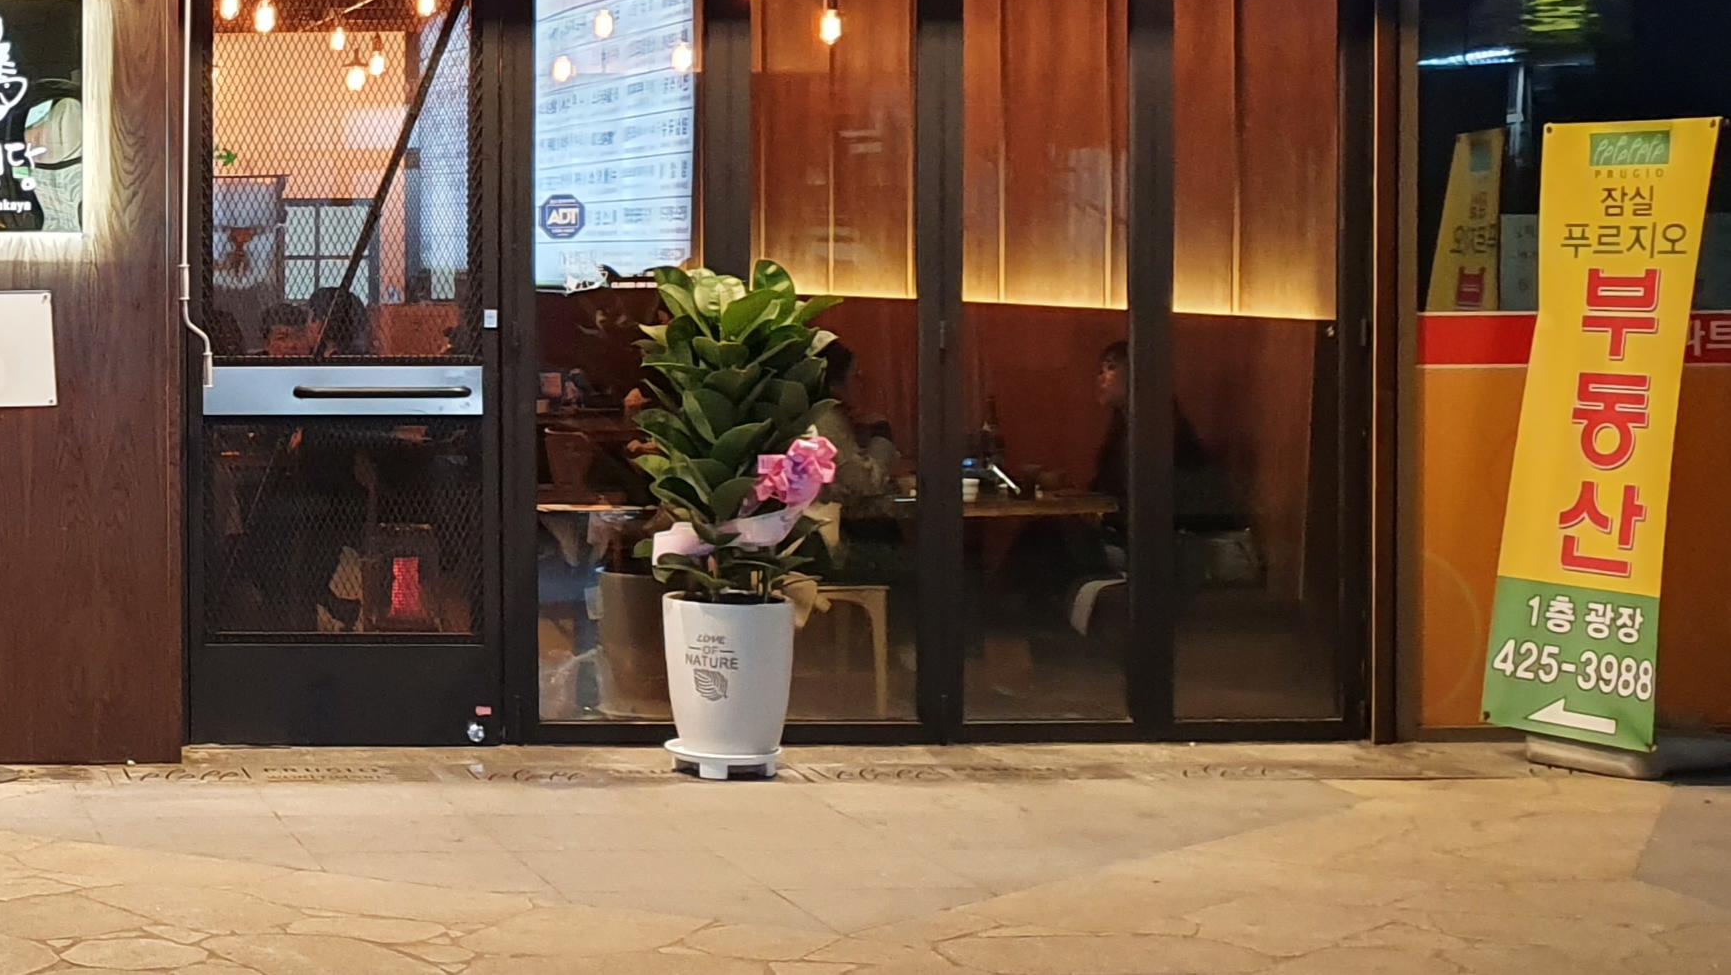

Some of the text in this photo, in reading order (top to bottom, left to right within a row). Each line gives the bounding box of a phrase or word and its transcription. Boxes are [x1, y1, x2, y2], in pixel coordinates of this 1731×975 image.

[1594, 168, 1665, 180] PRUGIO
[1601, 185, 1654, 217] 잠실
[547, 208, 579, 225] ADT
[1560, 222, 1688, 259] 푸르지오
[1559, 268, 1660, 578] 부동산
[1528, 595, 1645, 644] 1층 광장
[697, 634, 727, 645] LOVE
[702, 646, 720, 656] OF
[685, 653, 739, 670] NATURE
[1492, 639, 1655, 701] 425-3988
